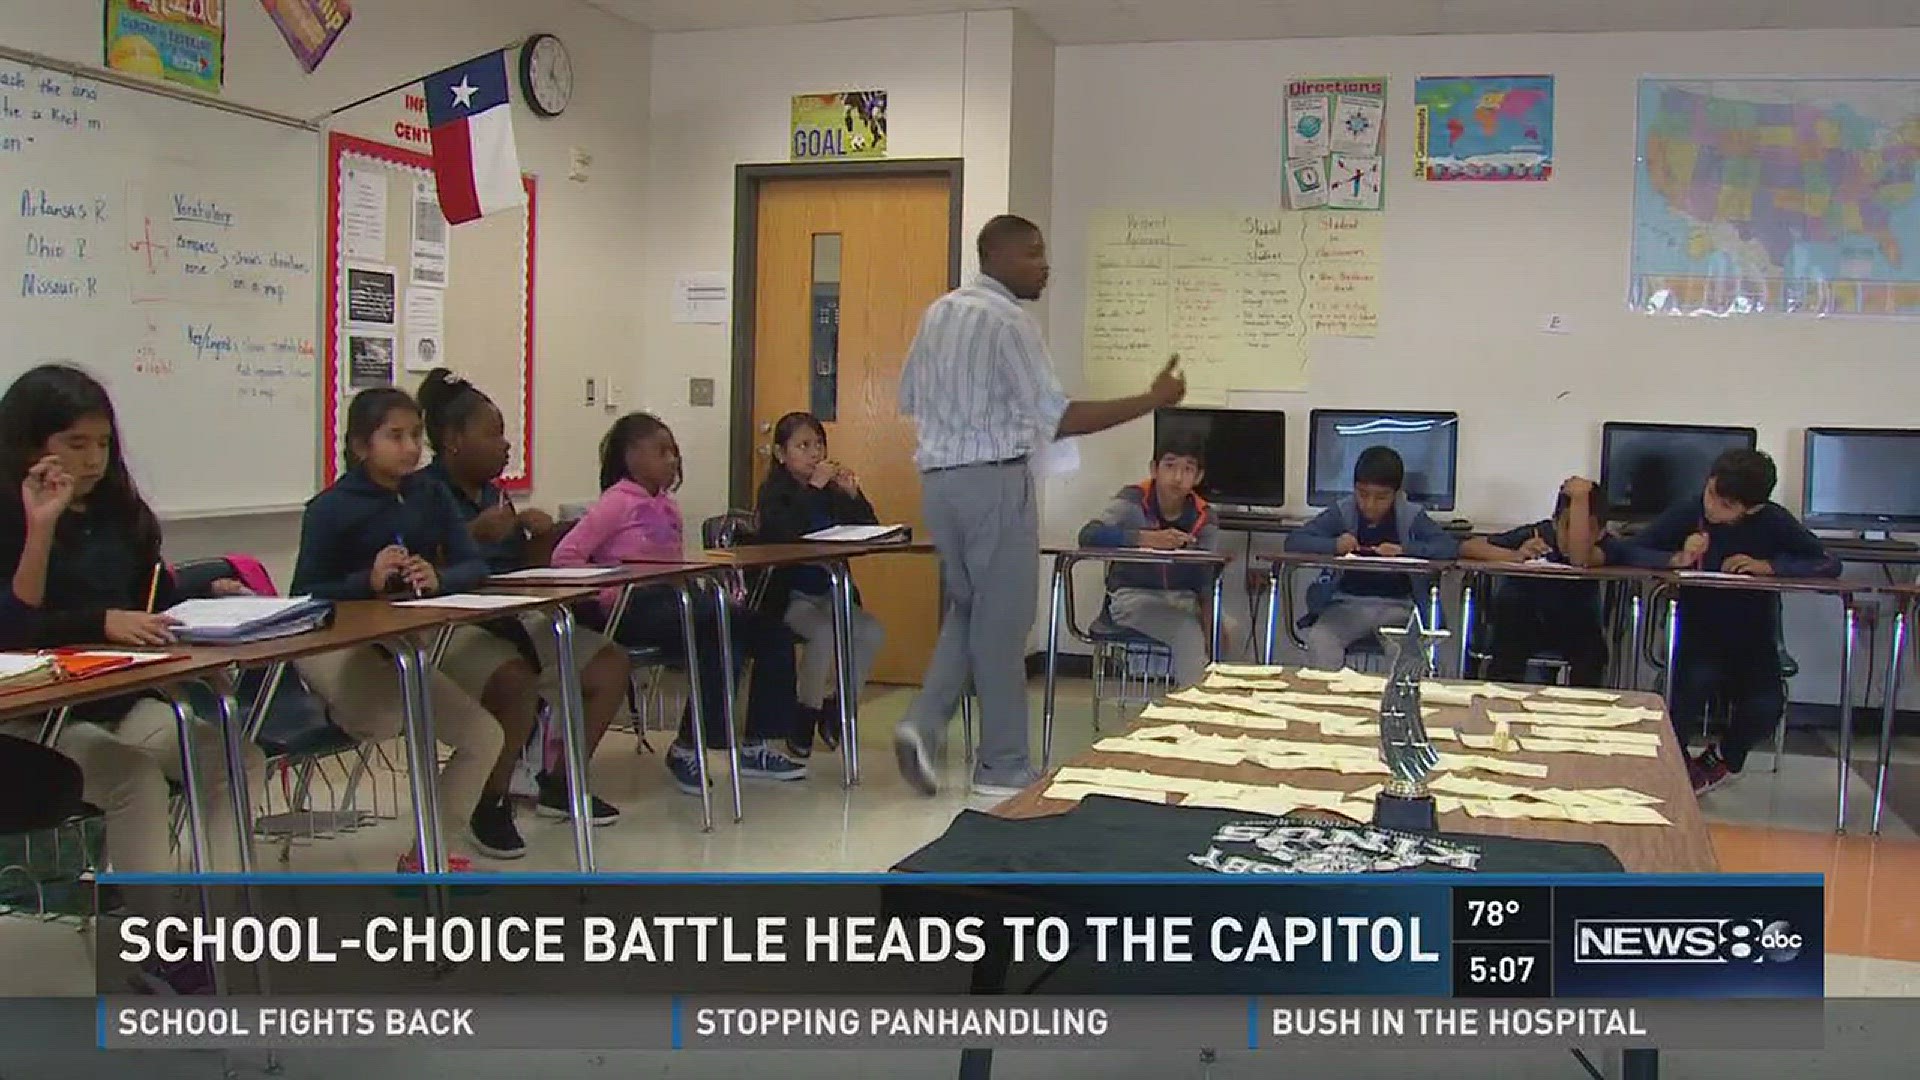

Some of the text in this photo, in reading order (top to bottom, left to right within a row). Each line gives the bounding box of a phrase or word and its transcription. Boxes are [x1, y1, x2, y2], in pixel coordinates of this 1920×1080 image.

[1289, 81, 1382, 97] Directions
[794, 129, 848, 157] GOAL
[21, 189, 87, 219] Arkansas
